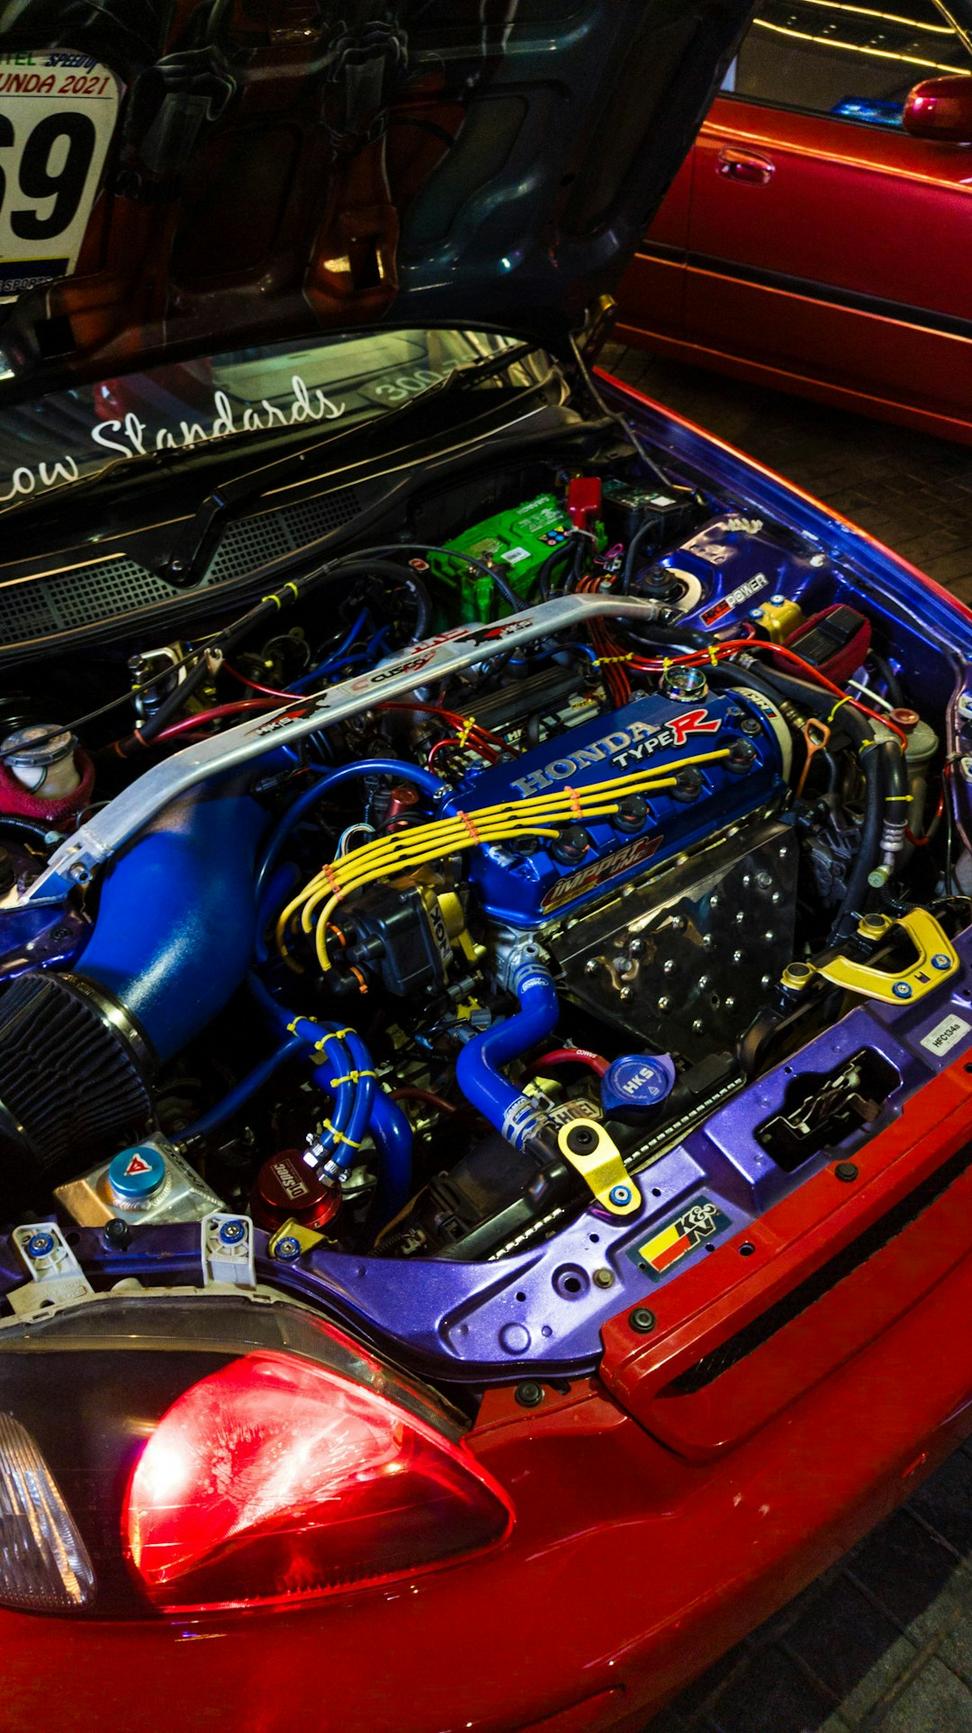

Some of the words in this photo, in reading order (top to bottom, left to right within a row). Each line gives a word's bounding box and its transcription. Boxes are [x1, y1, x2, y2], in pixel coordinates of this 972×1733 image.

[0, 52, 36, 66] TEL
[57, 75, 110, 95] 2021
[0, 111, 96, 241] 9
[0, 456, 79, 500] ow
[91, 376, 346, 458] Standards
[725, 573, 768, 608] POWER
[611, 731, 674, 770] TYPE
[664, 708, 722, 746] R
[510, 720, 661, 798] HONDA
[932, 1024, 961, 1048] HFC134a
[622, 1067, 655, 1095] HKS
[674, 1203, 717, 1246] K&N
